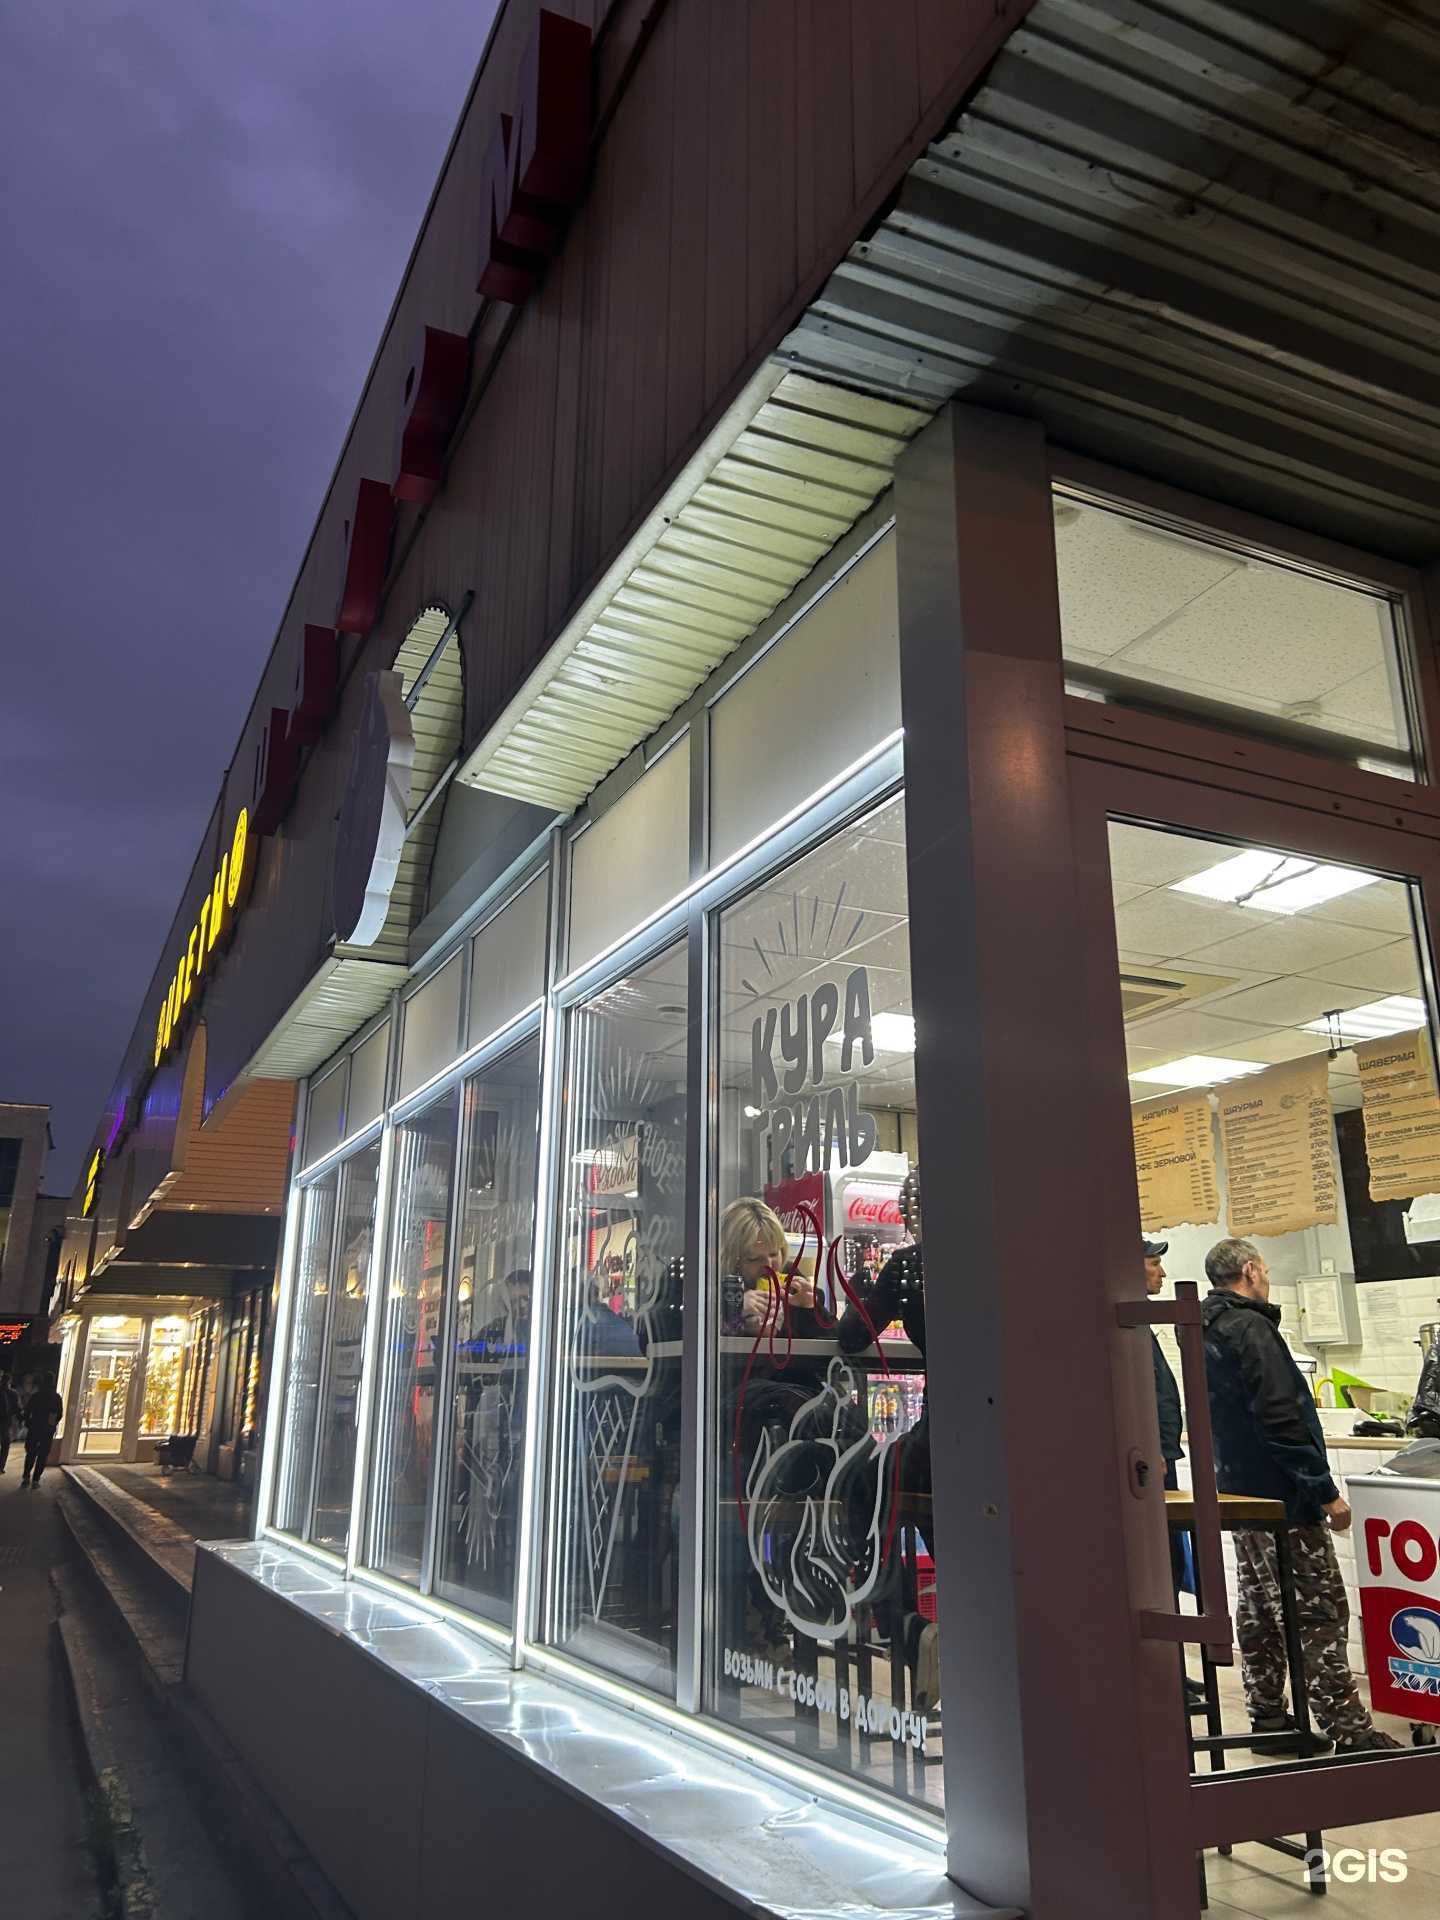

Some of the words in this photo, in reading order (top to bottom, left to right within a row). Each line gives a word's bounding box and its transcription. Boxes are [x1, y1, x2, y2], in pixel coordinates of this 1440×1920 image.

[752, 966, 875, 1105] КУРА
[1359, 1051, 1415, 1071] ШАВЕРМА
[1142, 1104, 1179, 1121] НАПИТКИ
[1224, 1099, 1263, 1115] ШАУРМА
[754, 1080, 876, 1193] ГРИЛЬ
[1136, 1162, 1152, 1171] ОФЕ
[1153, 1150, 1197, 1168] ЗЕРНОВОЙ
[1363, 1517, 1440, 1583] ГО
[1390, 1670, 1440, 1697] ХОЛ
[723, 1647, 773, 1690] ВОЗЬМИ
[776, 1665, 786, 1696] С
[788, 1670, 837, 1714] СОБОЙ
[839, 1687, 850, 1720] В
[854, 1694, 928, 1752] ДОРОГУ!
